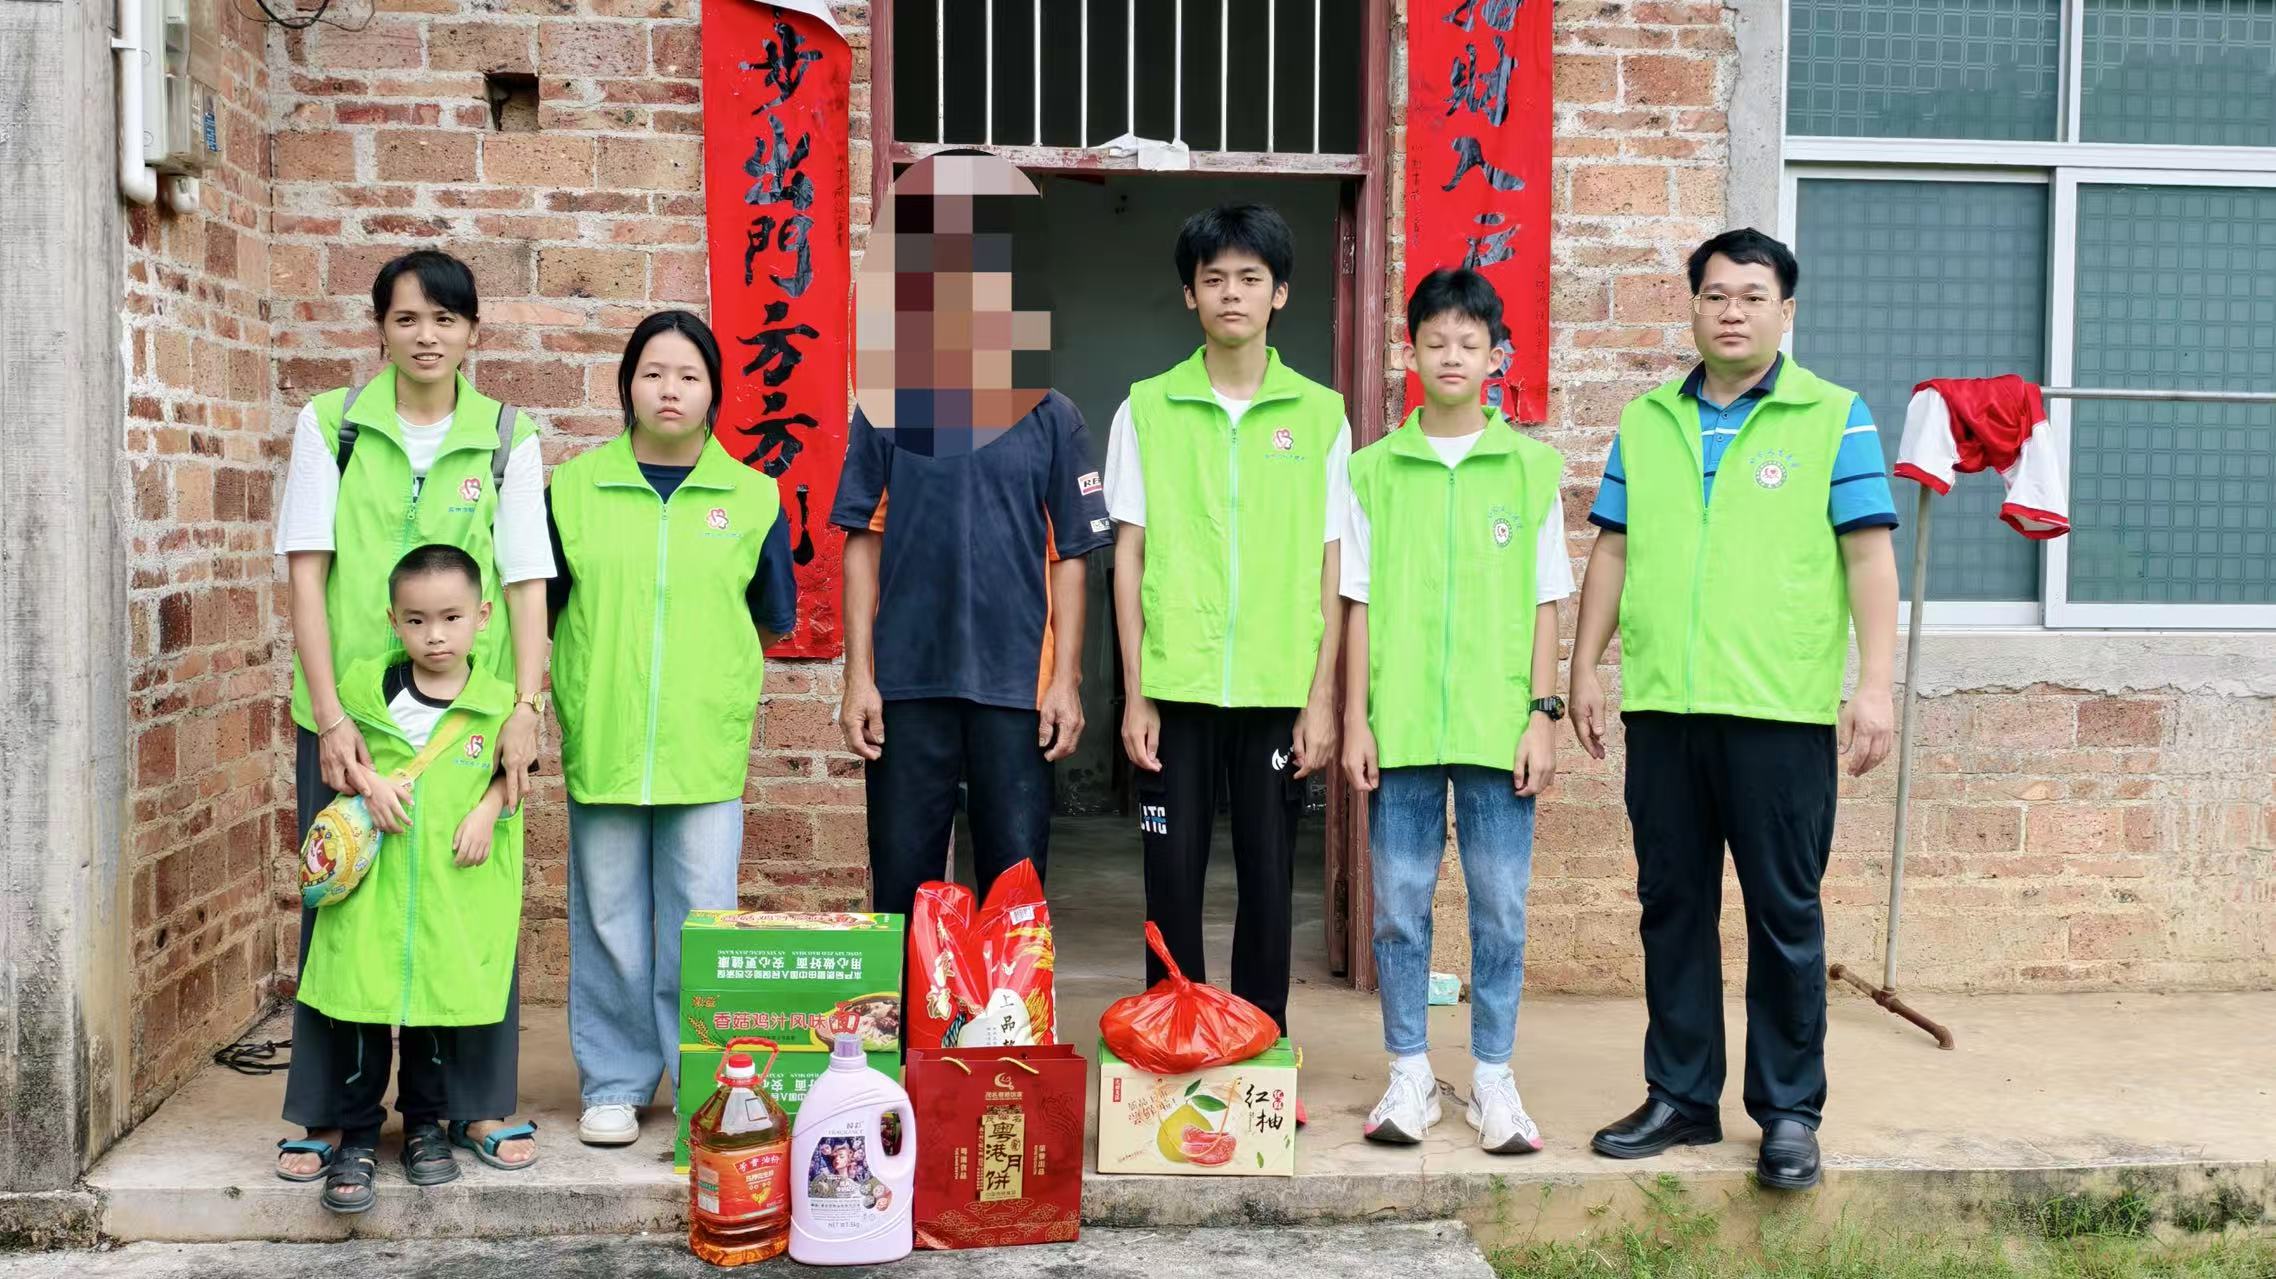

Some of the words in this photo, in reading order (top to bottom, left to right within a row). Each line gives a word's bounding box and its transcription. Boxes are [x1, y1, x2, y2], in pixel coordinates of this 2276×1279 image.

[718, 956, 785, 970] 安心更健康
[796, 956, 862, 970] 用心做好面
[713, 1010, 828, 1031] 香菇鸡汁风味
